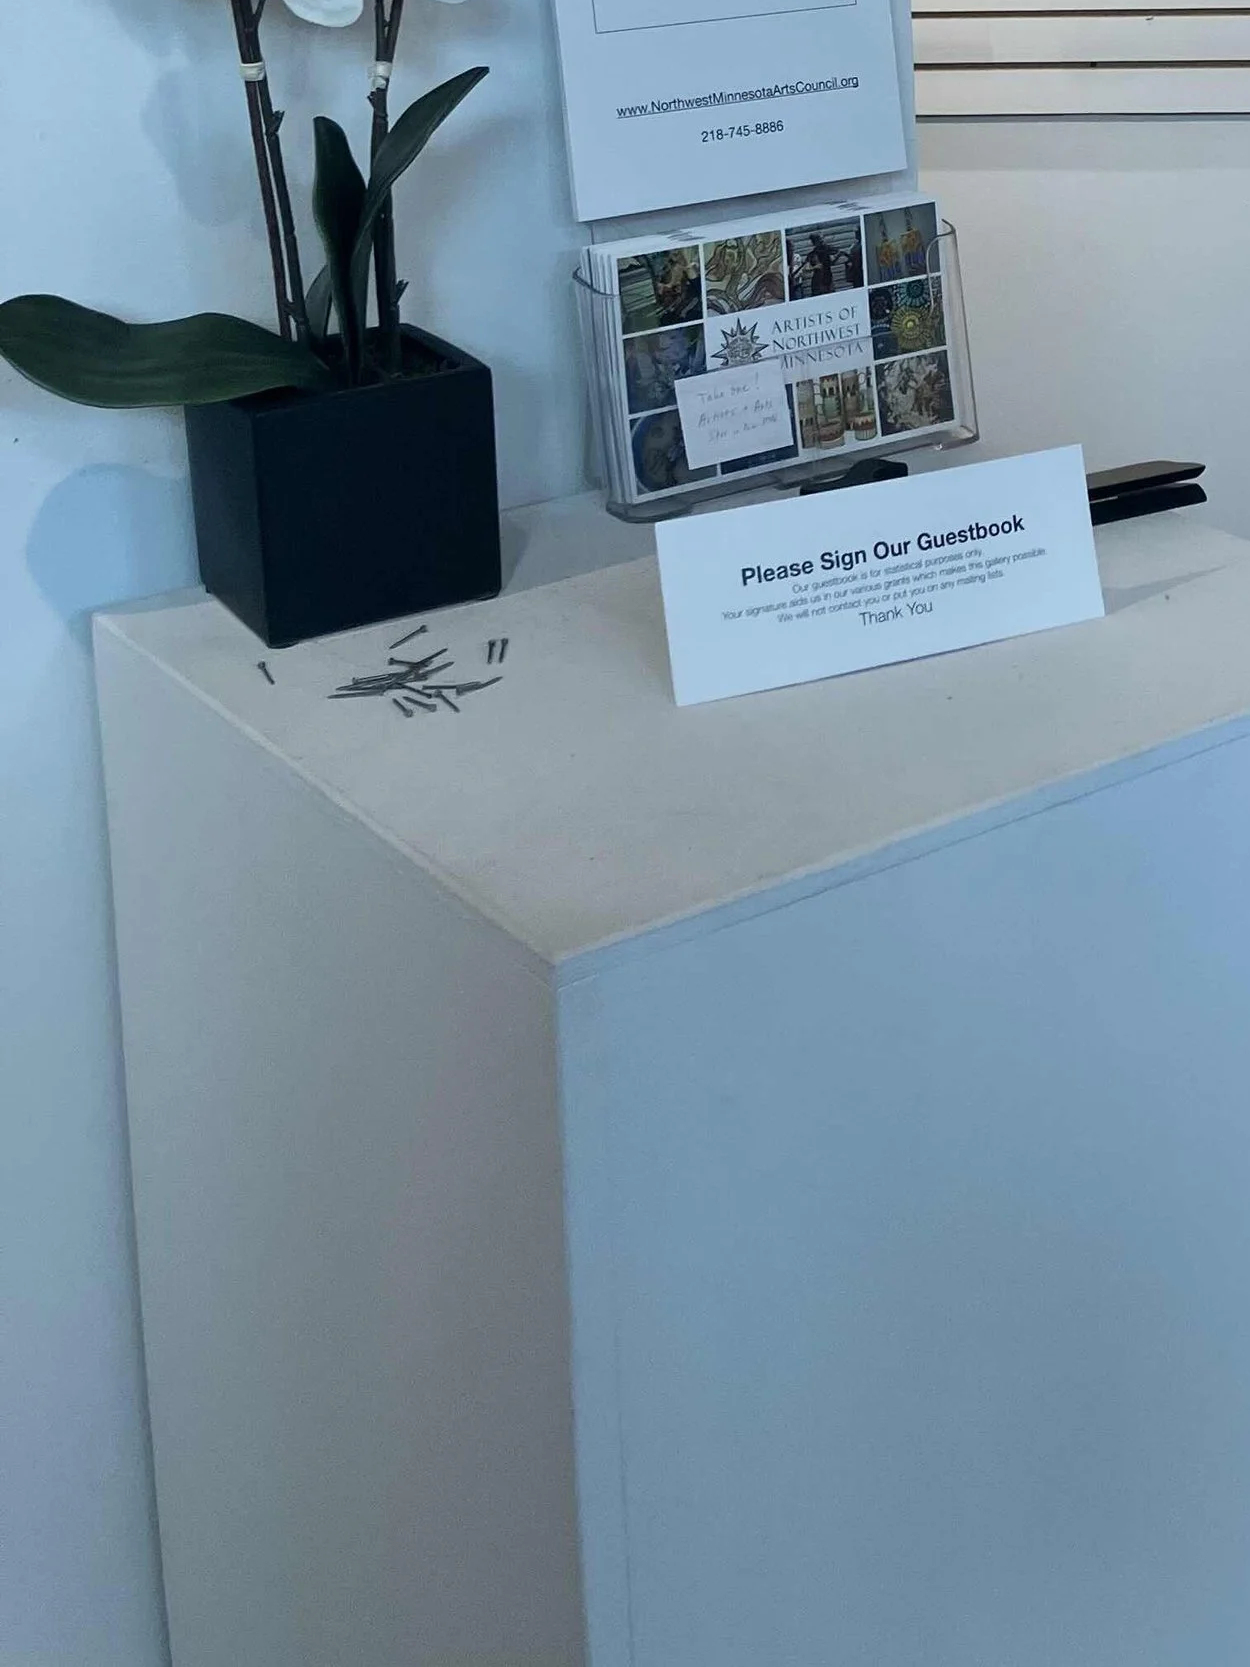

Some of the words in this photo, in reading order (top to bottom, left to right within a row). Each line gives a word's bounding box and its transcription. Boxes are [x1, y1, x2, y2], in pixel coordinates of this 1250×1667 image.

[616, 76, 859, 117] www.NorthwestMinnesotaArtsCouncil.org
[701, 119, 784, 143] 218-745-8886
[771, 310, 833, 334] ARTISTS
[838, 305, 858, 321] OF
[772, 323, 861, 353] NORTHWEST
[741, 560, 815, 586] Please
[820, 549, 867, 571] Sign
[873, 540, 912, 560] Our
[916, 514, 1026, 551] Guestbook
[722, 610, 743, 621] Your
[745, 601, 788, 618] signature
[810, 594, 822, 603] us
[823, 593, 832, 602] in
[833, 589, 848, 599] our
[849, 582, 883, 596] various
[884, 575, 911, 592] grants
[912, 570, 937, 583] which
[939, 563, 967, 576] makes
[968, 560, 984, 571] this
[985, 554, 1011, 569] gallery
[792, 583, 809, 594] Our
[812, 574, 858, 592] guestbook
[860, 571, 868, 580] is
[869, 569, 881, 578] for
[884, 559, 923, 575] statistical
[924, 552, 964, 568] purposes
[811, 606, 827, 617] not
[828, 599, 862, 614] contact
[863, 596, 880, 608] you
[881, 593, 891, 601] or
[893, 589, 908, 601] put
[909, 587, 926, 598] you
[927, 584, 939, 593] on
[940, 580, 956, 591] any
[956, 573, 986, 586] mailing
[859, 605, 904, 626] Thank
[906, 600, 934, 617] You
